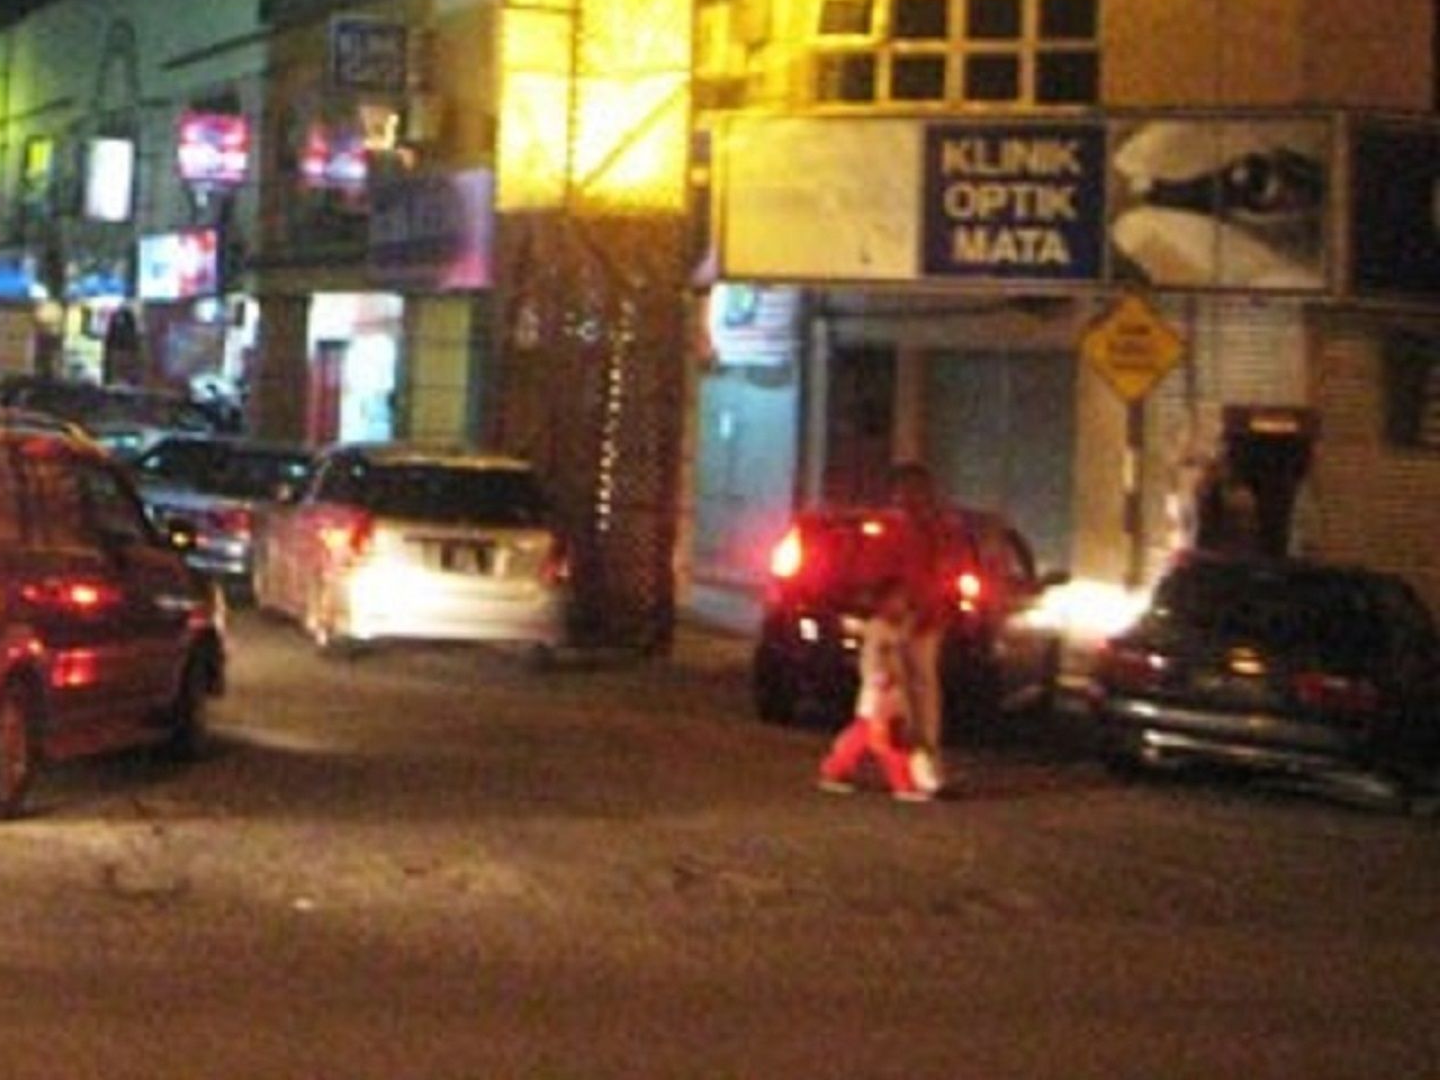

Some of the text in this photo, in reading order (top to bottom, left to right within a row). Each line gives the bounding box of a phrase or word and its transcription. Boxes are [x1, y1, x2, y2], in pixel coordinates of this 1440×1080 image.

[942, 136, 1082, 174] KLINIK
[943, 181, 1078, 220] OPTIK
[953, 224, 1071, 264] MATA
